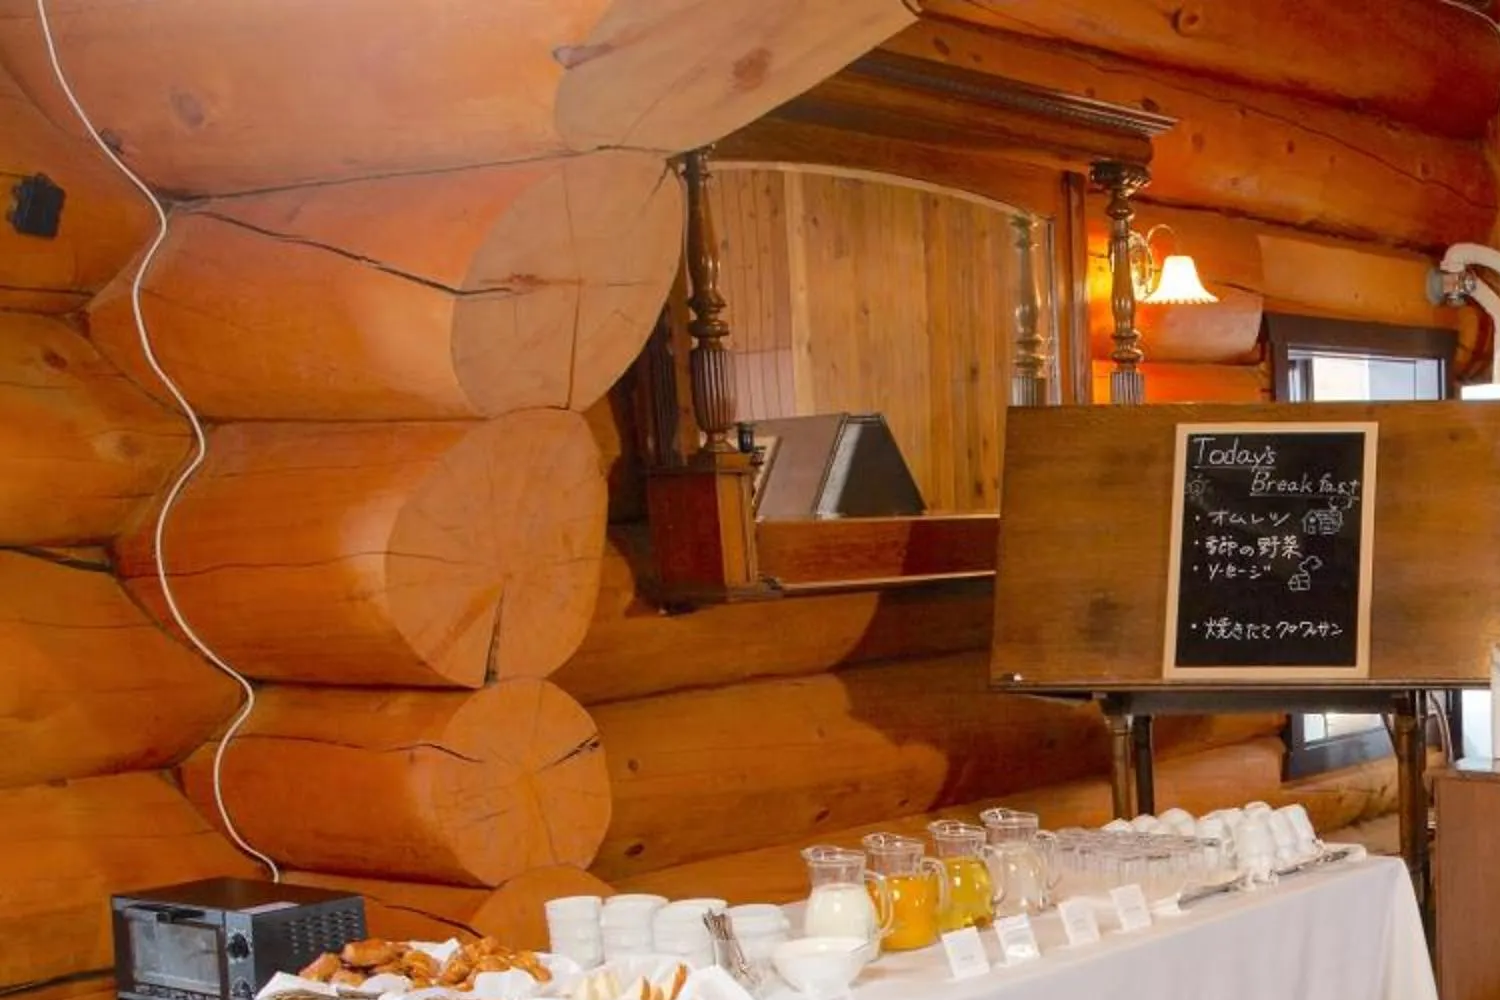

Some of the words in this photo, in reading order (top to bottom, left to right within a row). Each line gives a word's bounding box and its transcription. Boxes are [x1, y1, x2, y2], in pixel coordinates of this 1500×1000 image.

[1193, 437, 1276, 472] Today's
[1208, 510, 1291, 527] オムレツ
[1209, 563, 1271, 581] ソーセージ
